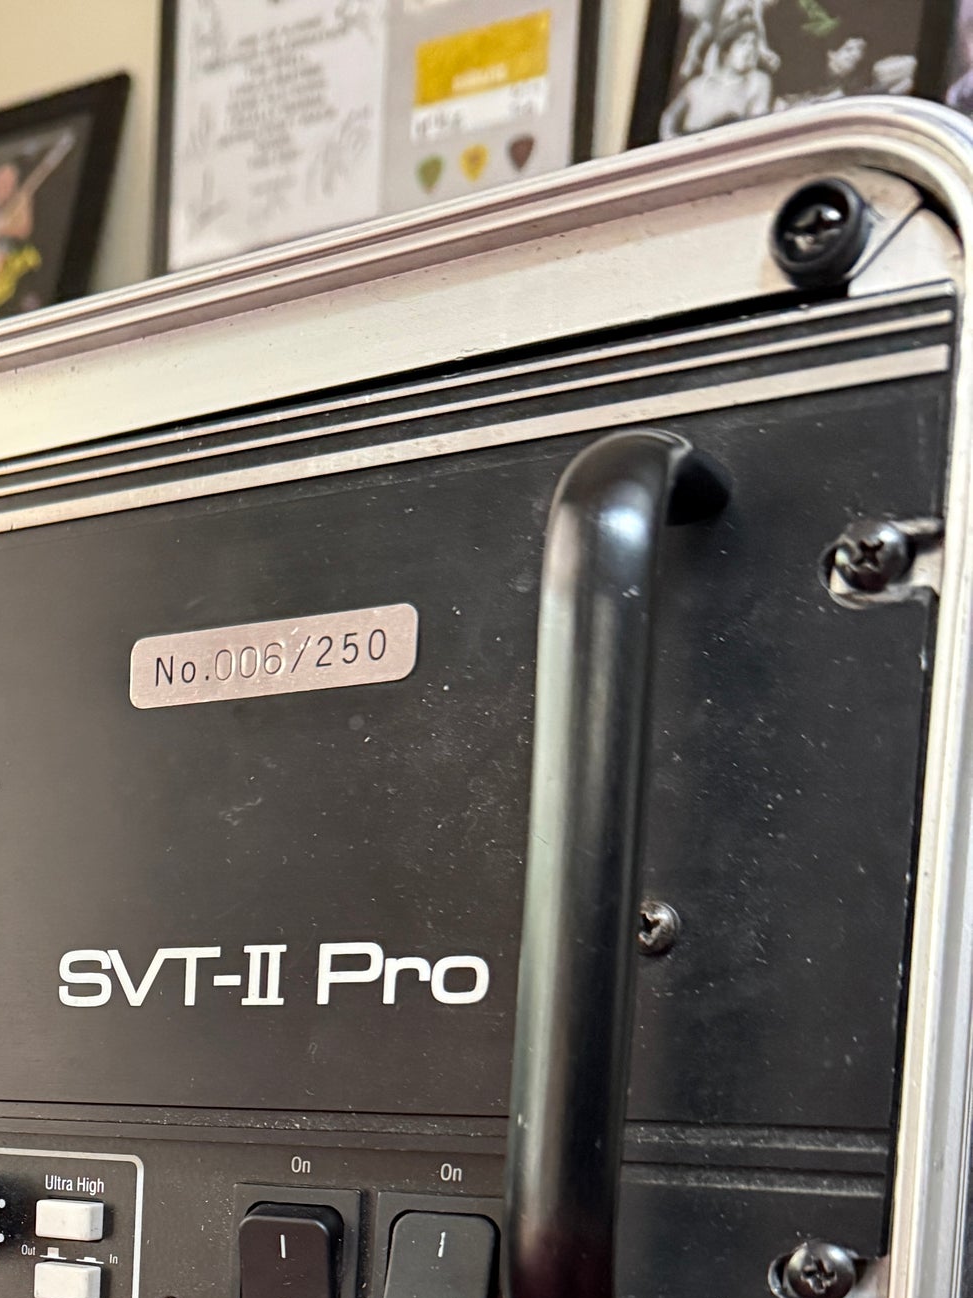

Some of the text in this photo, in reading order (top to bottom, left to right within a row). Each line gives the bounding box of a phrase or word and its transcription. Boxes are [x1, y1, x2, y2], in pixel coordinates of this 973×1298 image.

[316, 941, 490, 1006] Pro
[291, 1156, 311, 1174] On
[440, 1163, 463, 1182] On
[45, 1174, 105, 1195] Ultra High
[21, 1244, 36, 1257] Out
[109, 1253, 119, 1265] In
